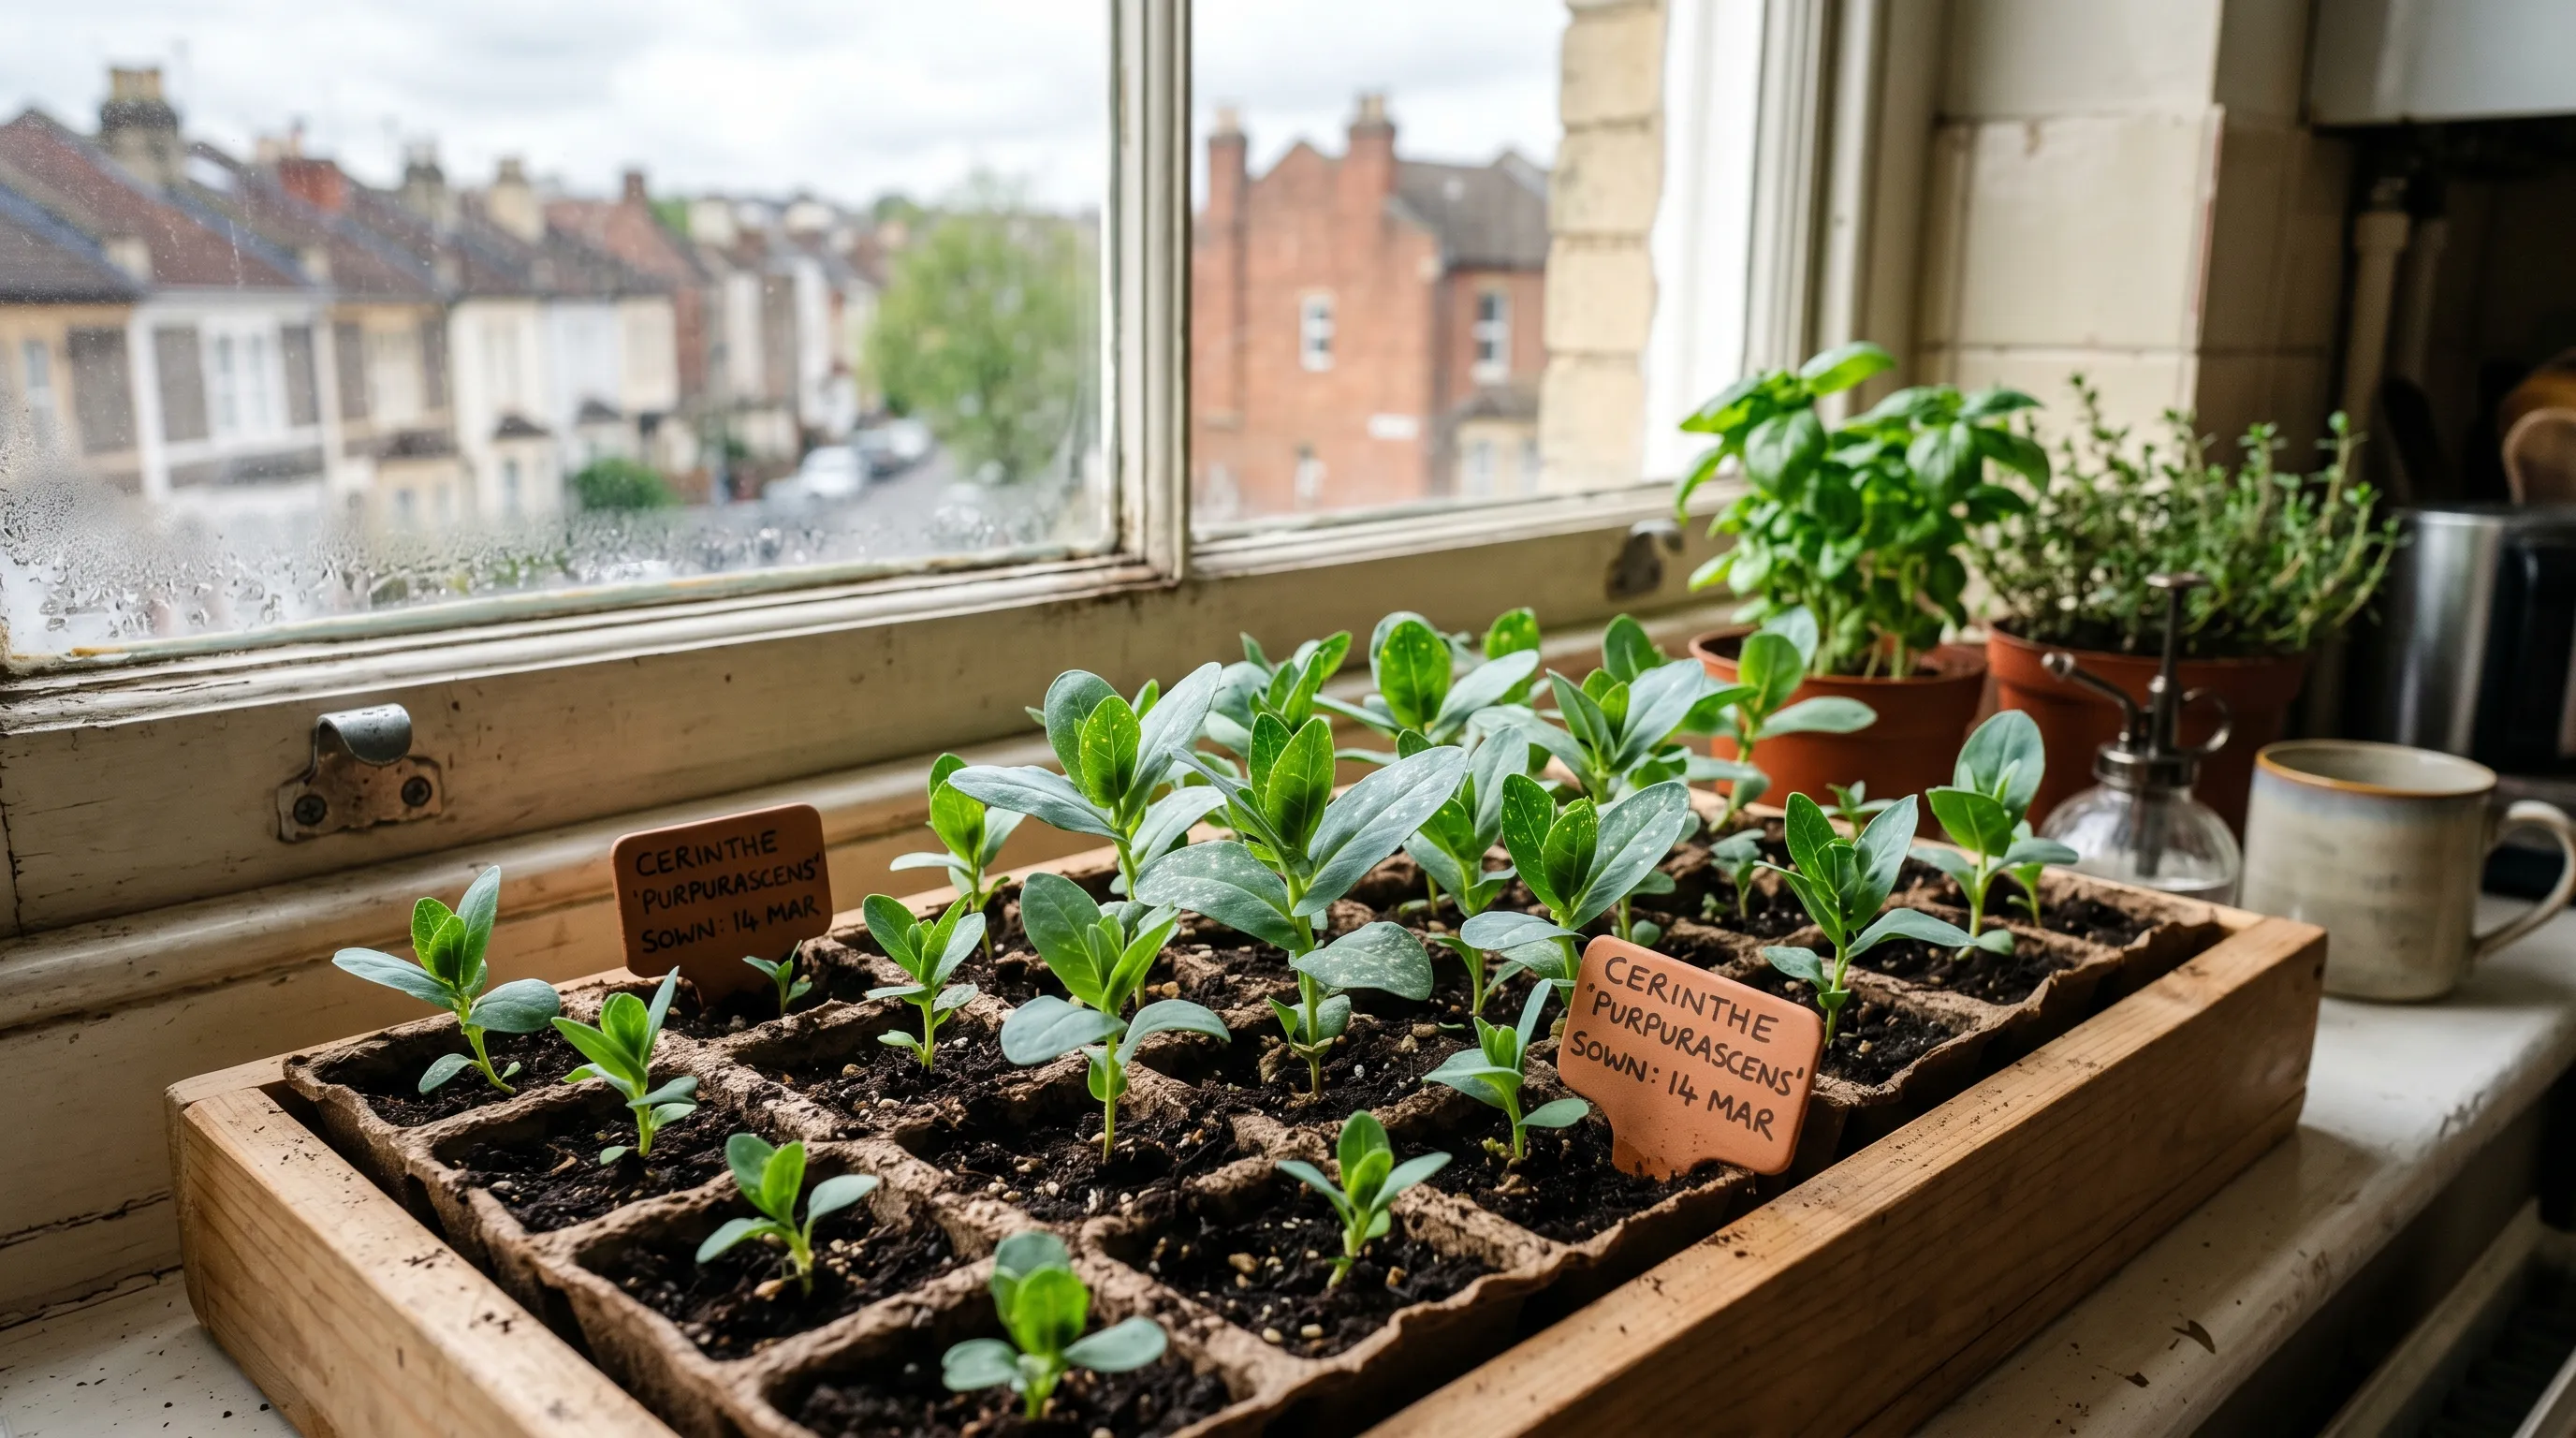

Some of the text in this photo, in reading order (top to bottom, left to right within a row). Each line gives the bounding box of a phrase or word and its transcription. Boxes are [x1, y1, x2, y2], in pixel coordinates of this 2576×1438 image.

[636, 830, 778, 876] CERINTHE
[641, 895, 821, 954] SOWN: 14 MAR
[1604, 956, 1778, 1043] CERINTHE
[1570, 1031, 1774, 1142] SOWN: 14 MAR
